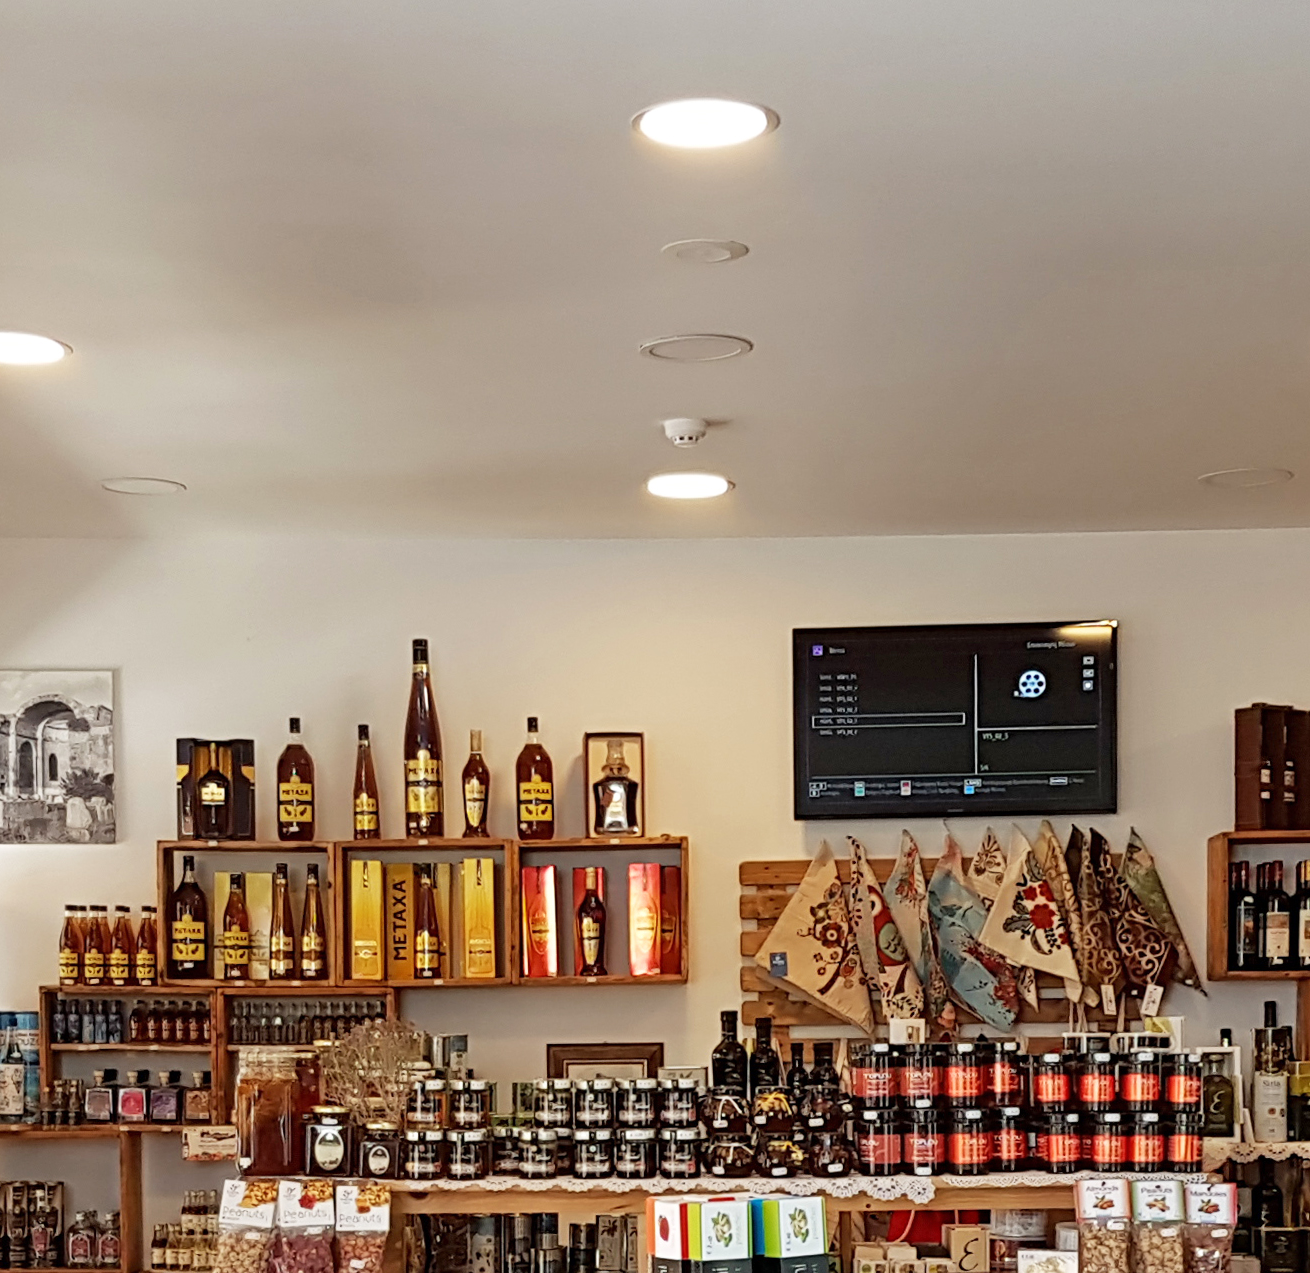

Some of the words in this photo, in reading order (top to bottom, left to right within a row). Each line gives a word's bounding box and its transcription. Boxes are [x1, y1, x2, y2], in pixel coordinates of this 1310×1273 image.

[393, 880, 408, 961] METAXA
[223, 1206, 264, 1221] Peanuts
[283, 1208, 328, 1221] Peanuts
[339, 1212, 382, 1225] Peanuts
